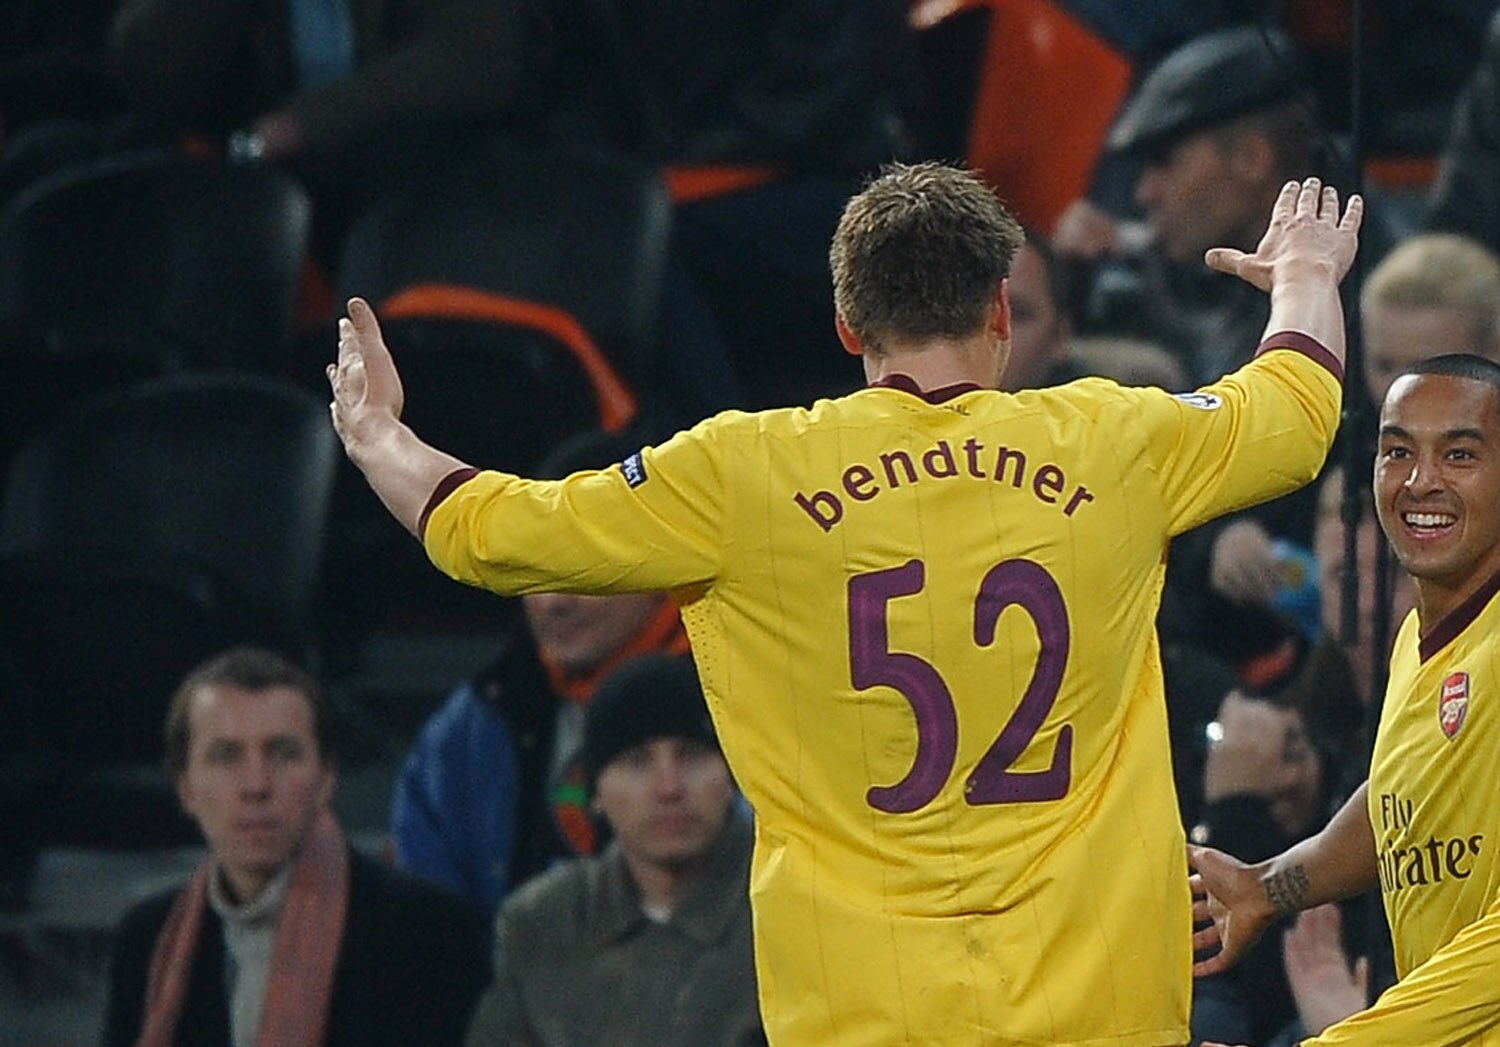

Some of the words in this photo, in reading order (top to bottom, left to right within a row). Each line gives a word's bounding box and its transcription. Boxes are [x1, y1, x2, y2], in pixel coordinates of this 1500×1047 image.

[795, 438, 1094, 532] bendtner
[848, 558, 1073, 813] 52
[1381, 793, 1412, 837] Fly
